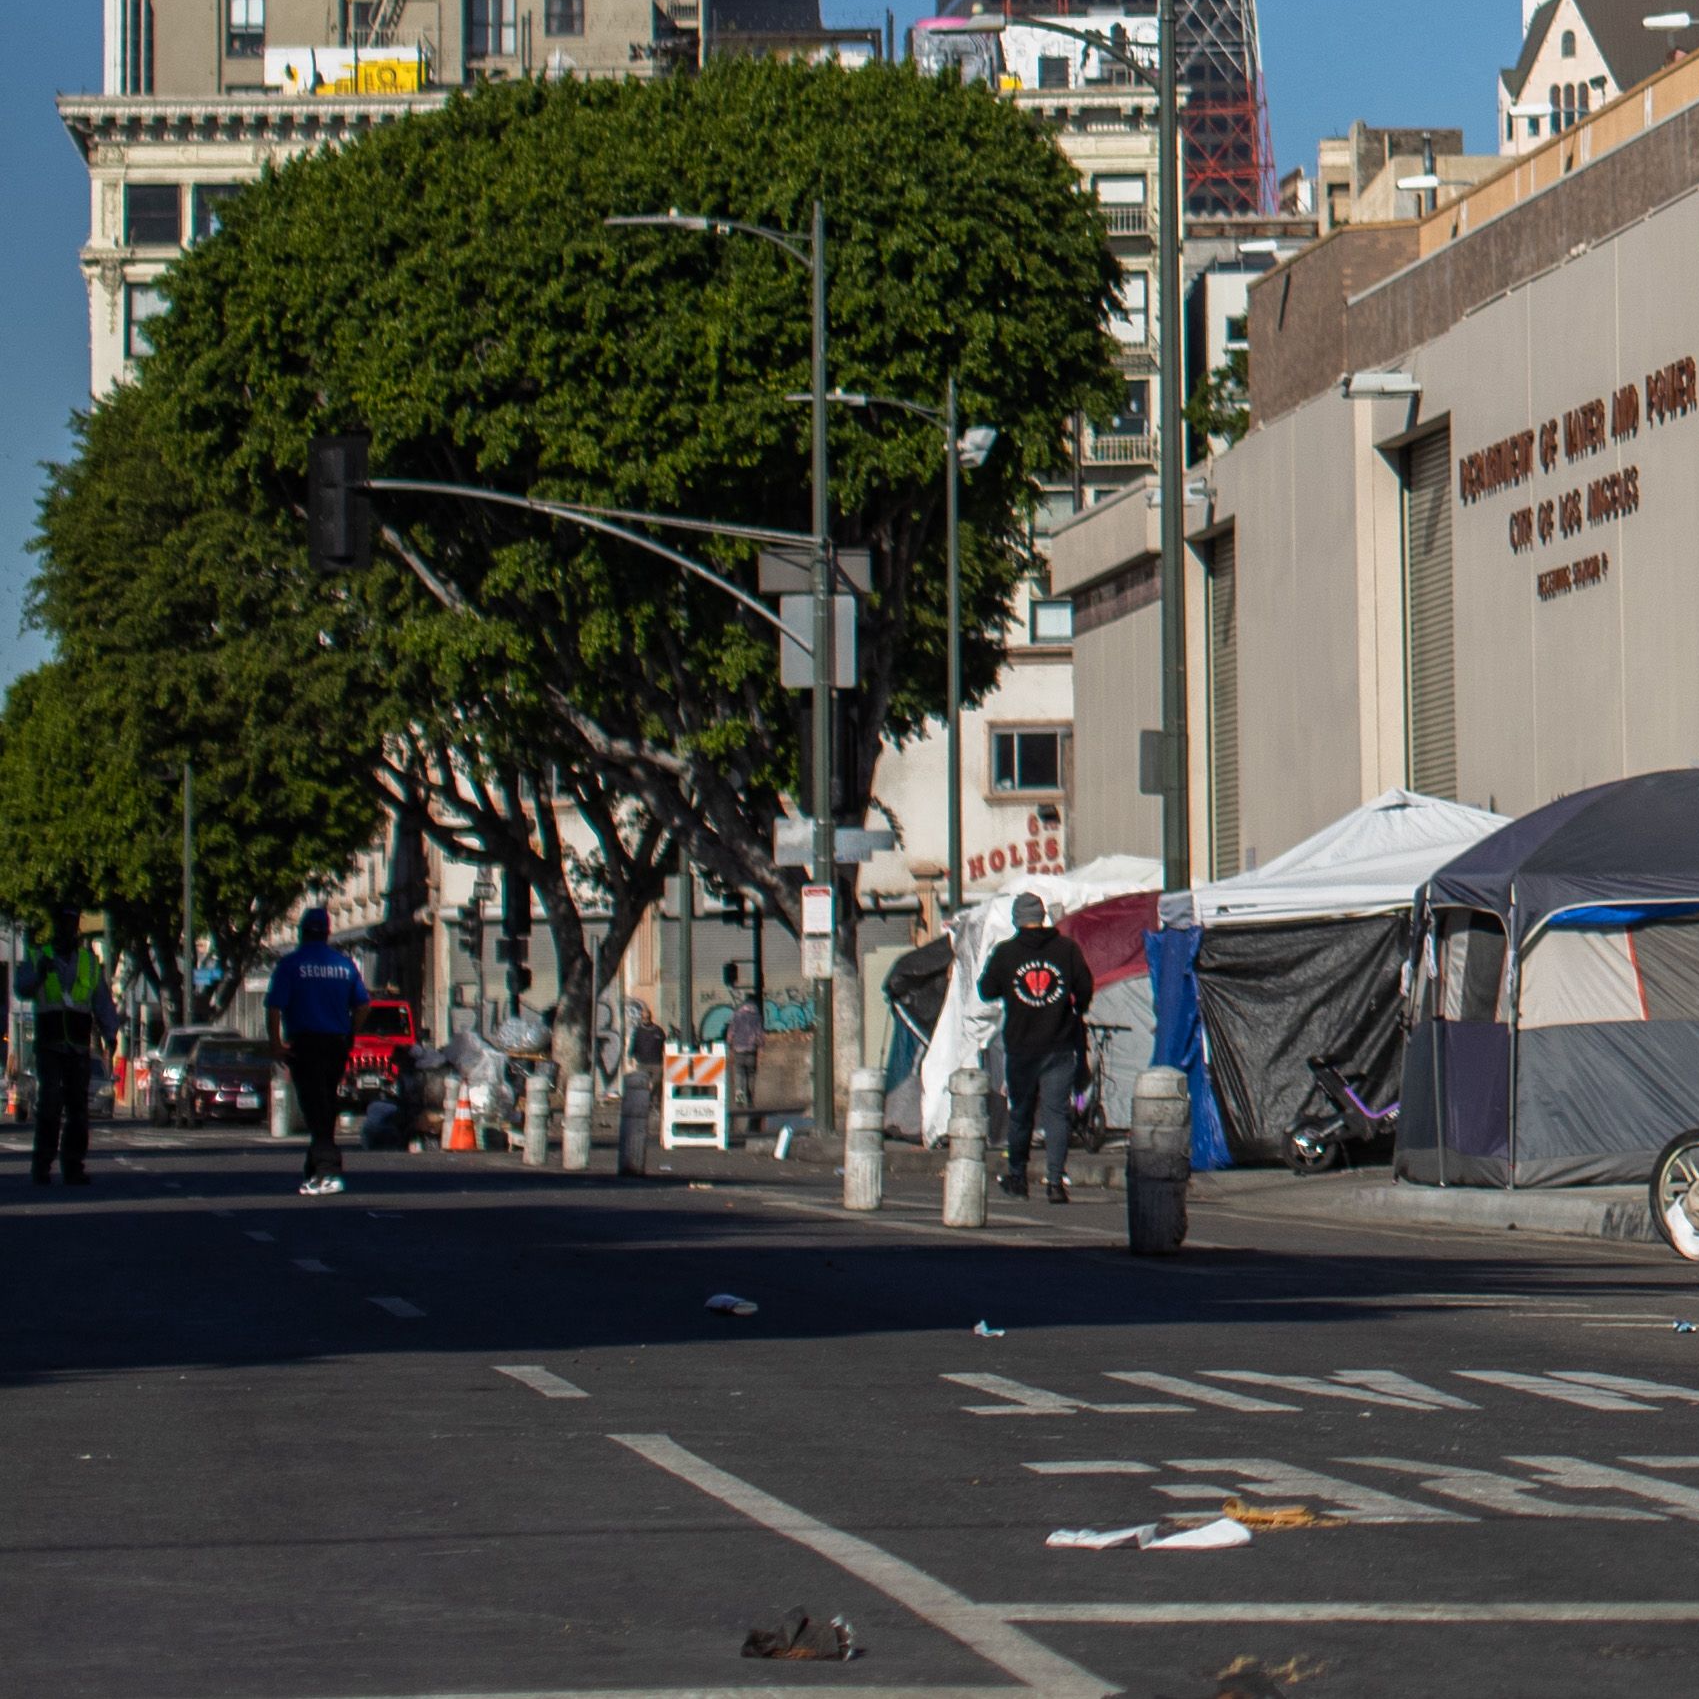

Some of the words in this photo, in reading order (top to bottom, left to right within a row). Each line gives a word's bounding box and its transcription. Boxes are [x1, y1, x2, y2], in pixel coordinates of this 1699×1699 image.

[1459, 428, 1535, 508] DEPARTMENT
[1539, 418, 1558, 475] OF
[1562, 397, 1606, 465] WATER
[1610, 383, 1639, 446] AND
[1645, 355, 1697, 429] POWER
[1509, 506, 1534, 555] CITY
[1537, 498, 1555, 546] OF
[1558, 488, 1582, 539] LOS
[1586, 465, 1639, 529] ANGELES
[299, 963, 350, 980] SECURITY
